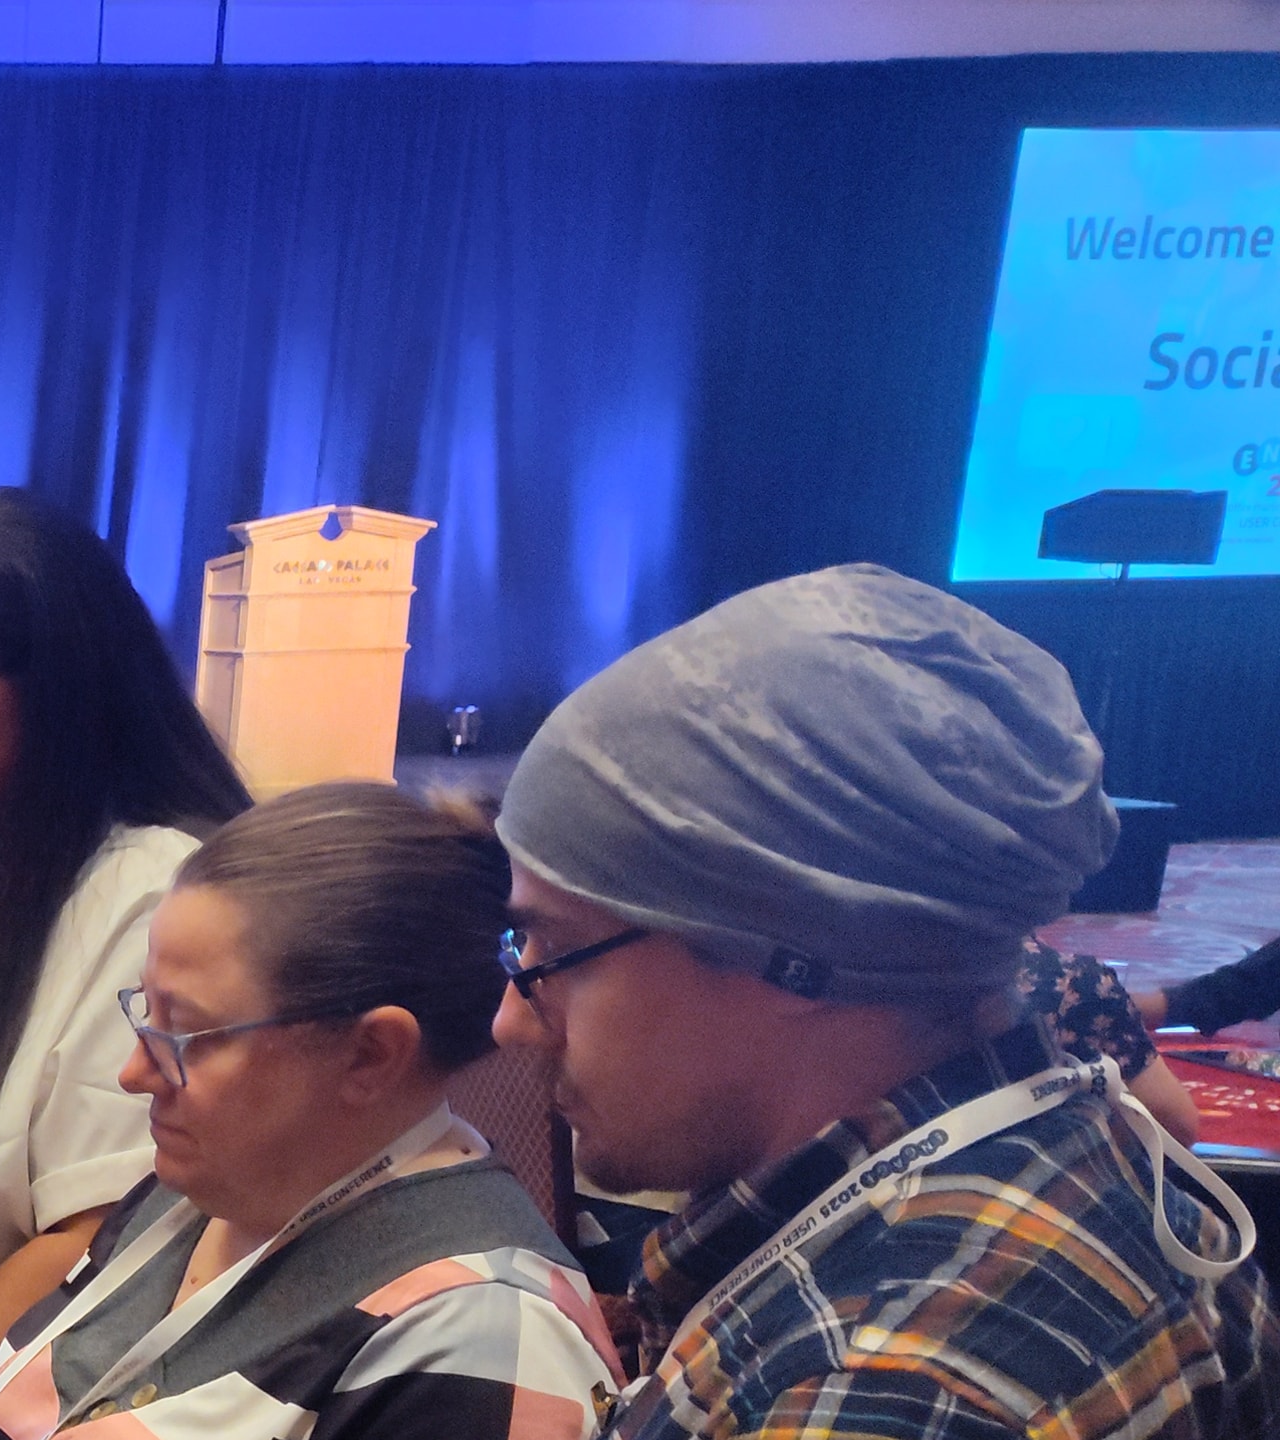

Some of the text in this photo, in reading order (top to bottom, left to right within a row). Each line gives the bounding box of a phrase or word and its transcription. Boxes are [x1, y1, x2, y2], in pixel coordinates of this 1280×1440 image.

[1065, 215, 1273, 261] Welcome
[327, 1155, 393, 1206] CONFERENCE
[819, 1182, 862, 1219] 2025
[783, 1217, 817, 1247] USER
[709, 1246, 782, 1310] CONFERENCE
